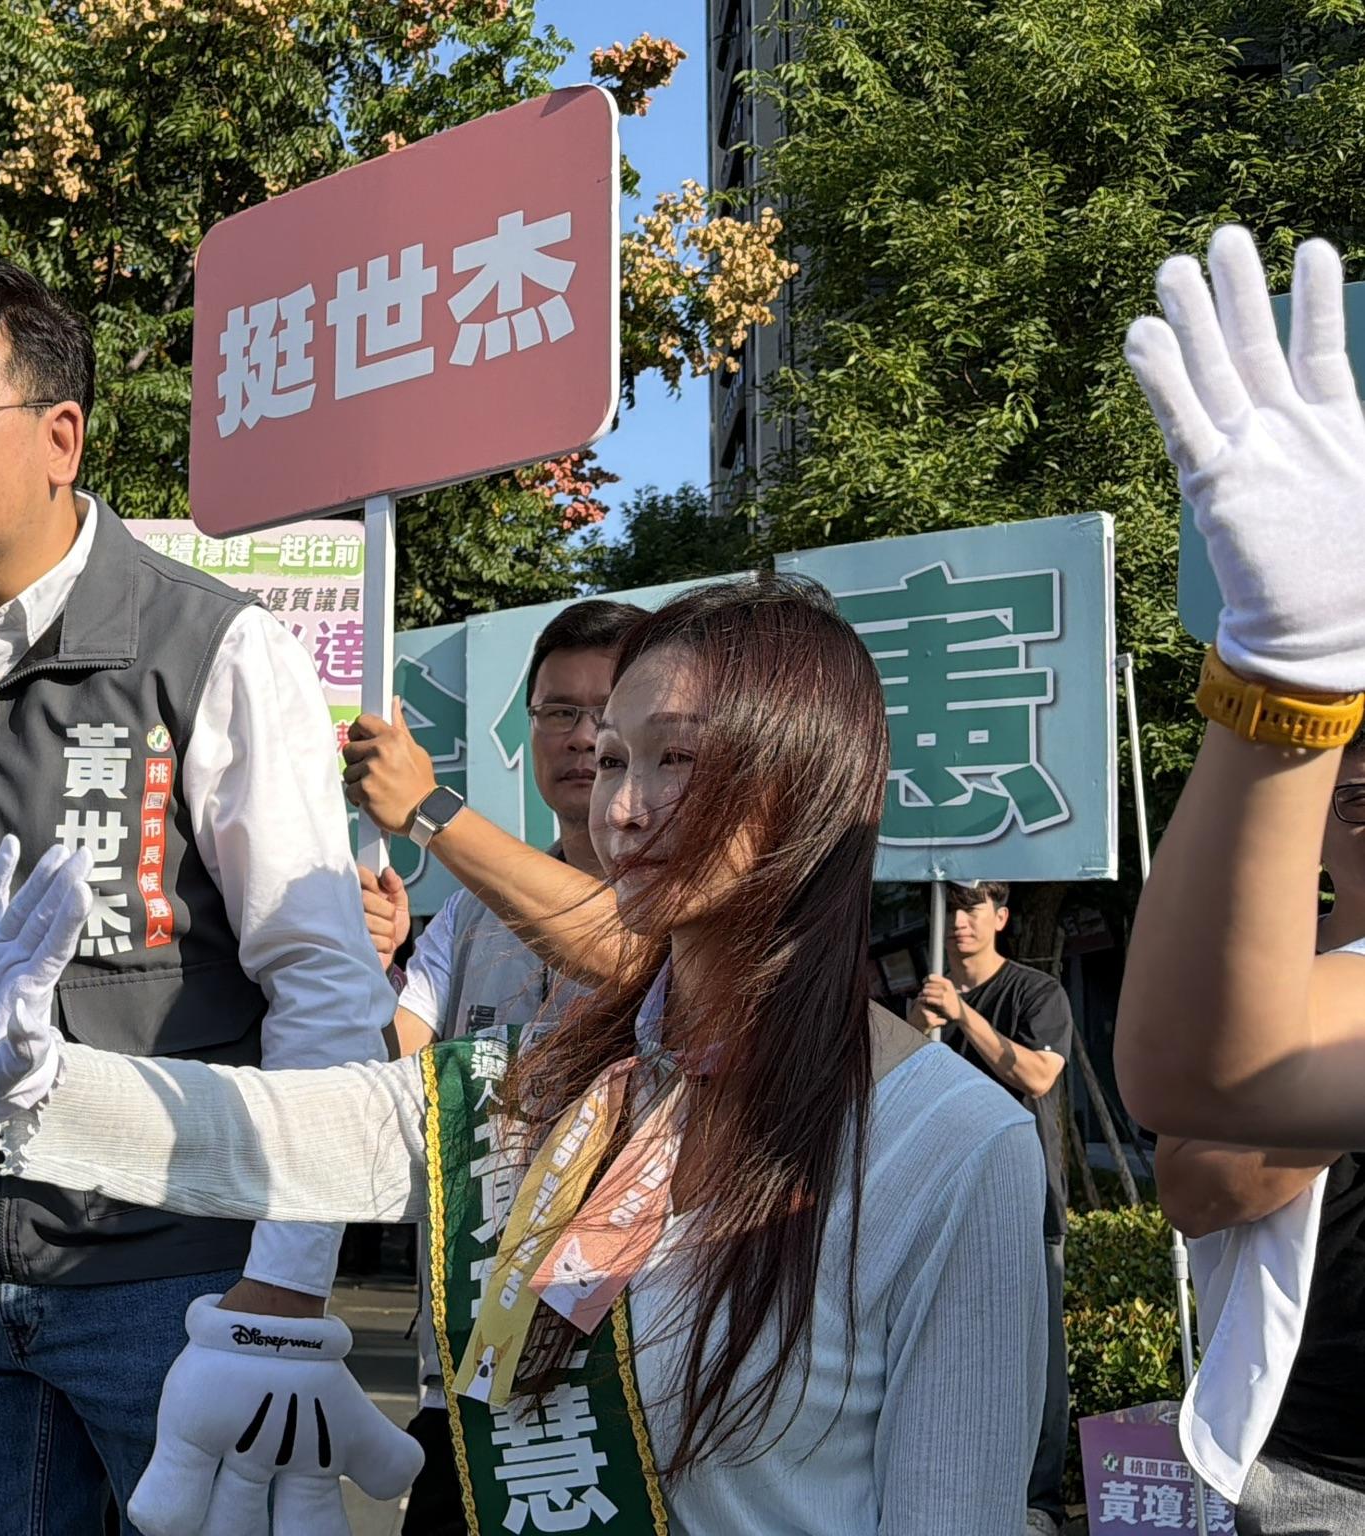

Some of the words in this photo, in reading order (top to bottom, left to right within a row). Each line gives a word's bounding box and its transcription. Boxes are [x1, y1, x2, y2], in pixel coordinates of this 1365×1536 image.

[217, 210, 576, 438] 挺世杰
[55, 723, 133, 956] 黃世杰
[139, 762, 170, 941] 桃園市長候選人
[470, 1113, 619, 1534] 黃慧
[1130, 1459, 1194, 1481] 桃園區市
